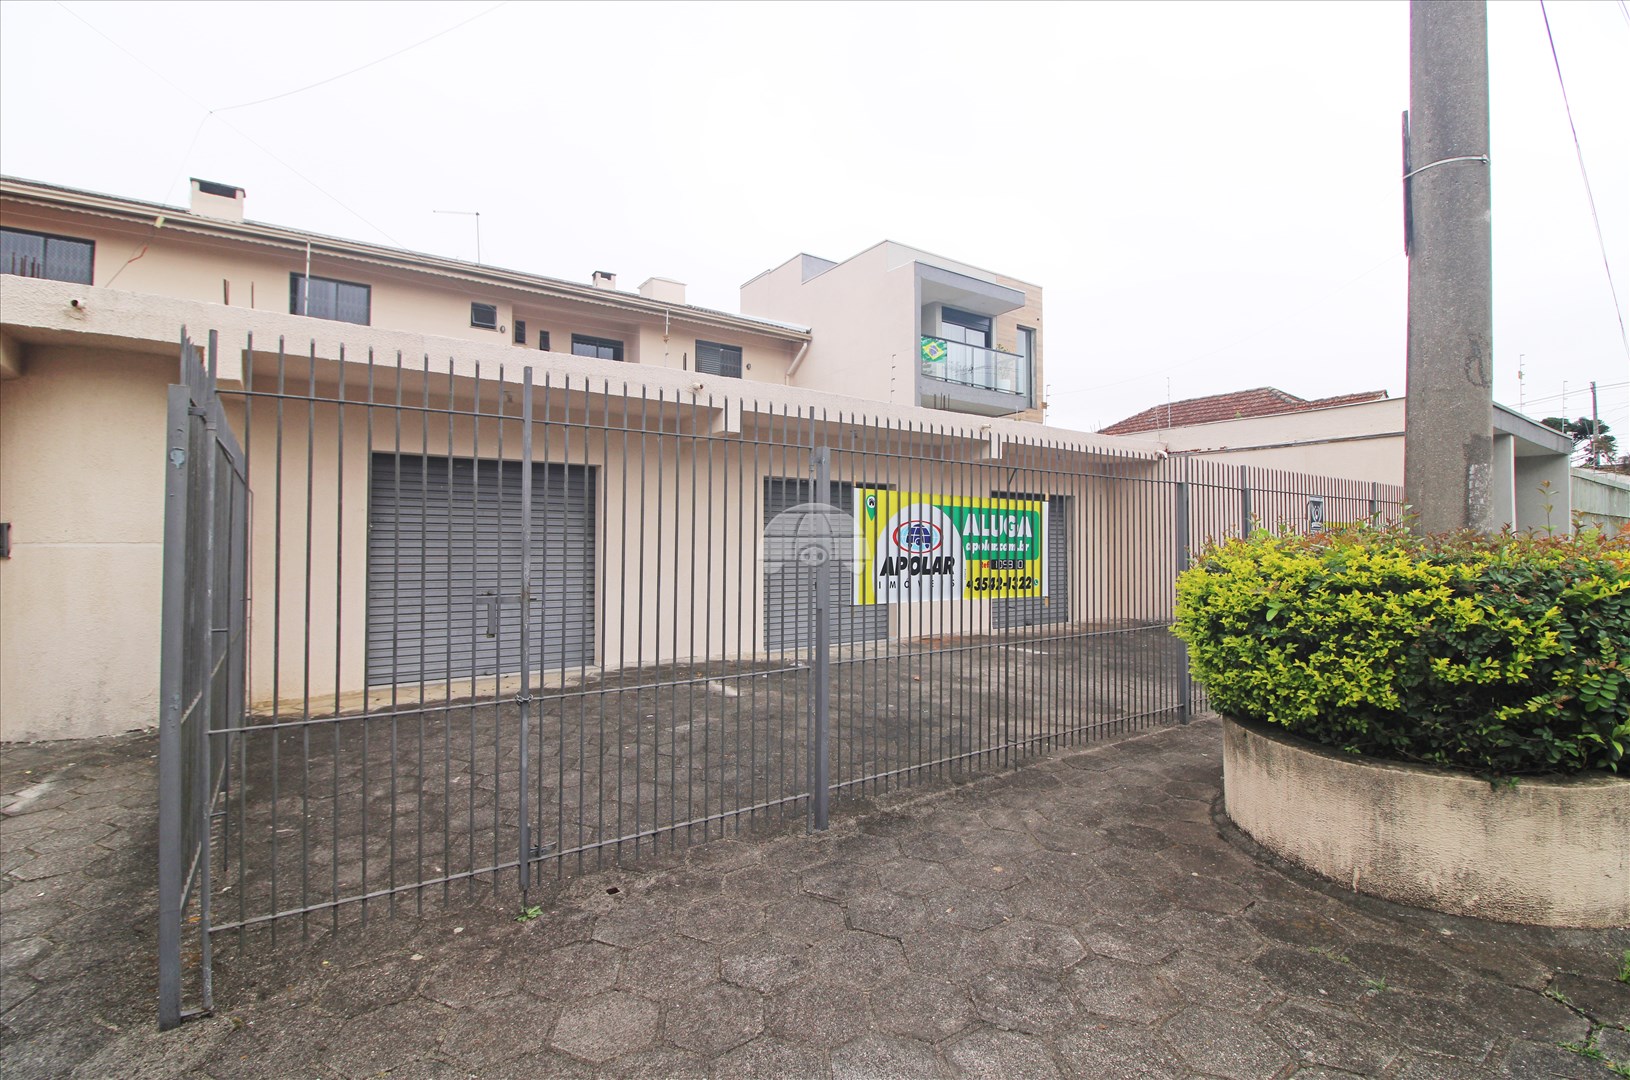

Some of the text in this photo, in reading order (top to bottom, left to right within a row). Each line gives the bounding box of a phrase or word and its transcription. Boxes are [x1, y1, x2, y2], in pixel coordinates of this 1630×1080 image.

[963, 513, 1032, 537] ALUGA
[879, 556, 956, 576] APOLAR
[878, 578, 955, 589] IMÓVES
